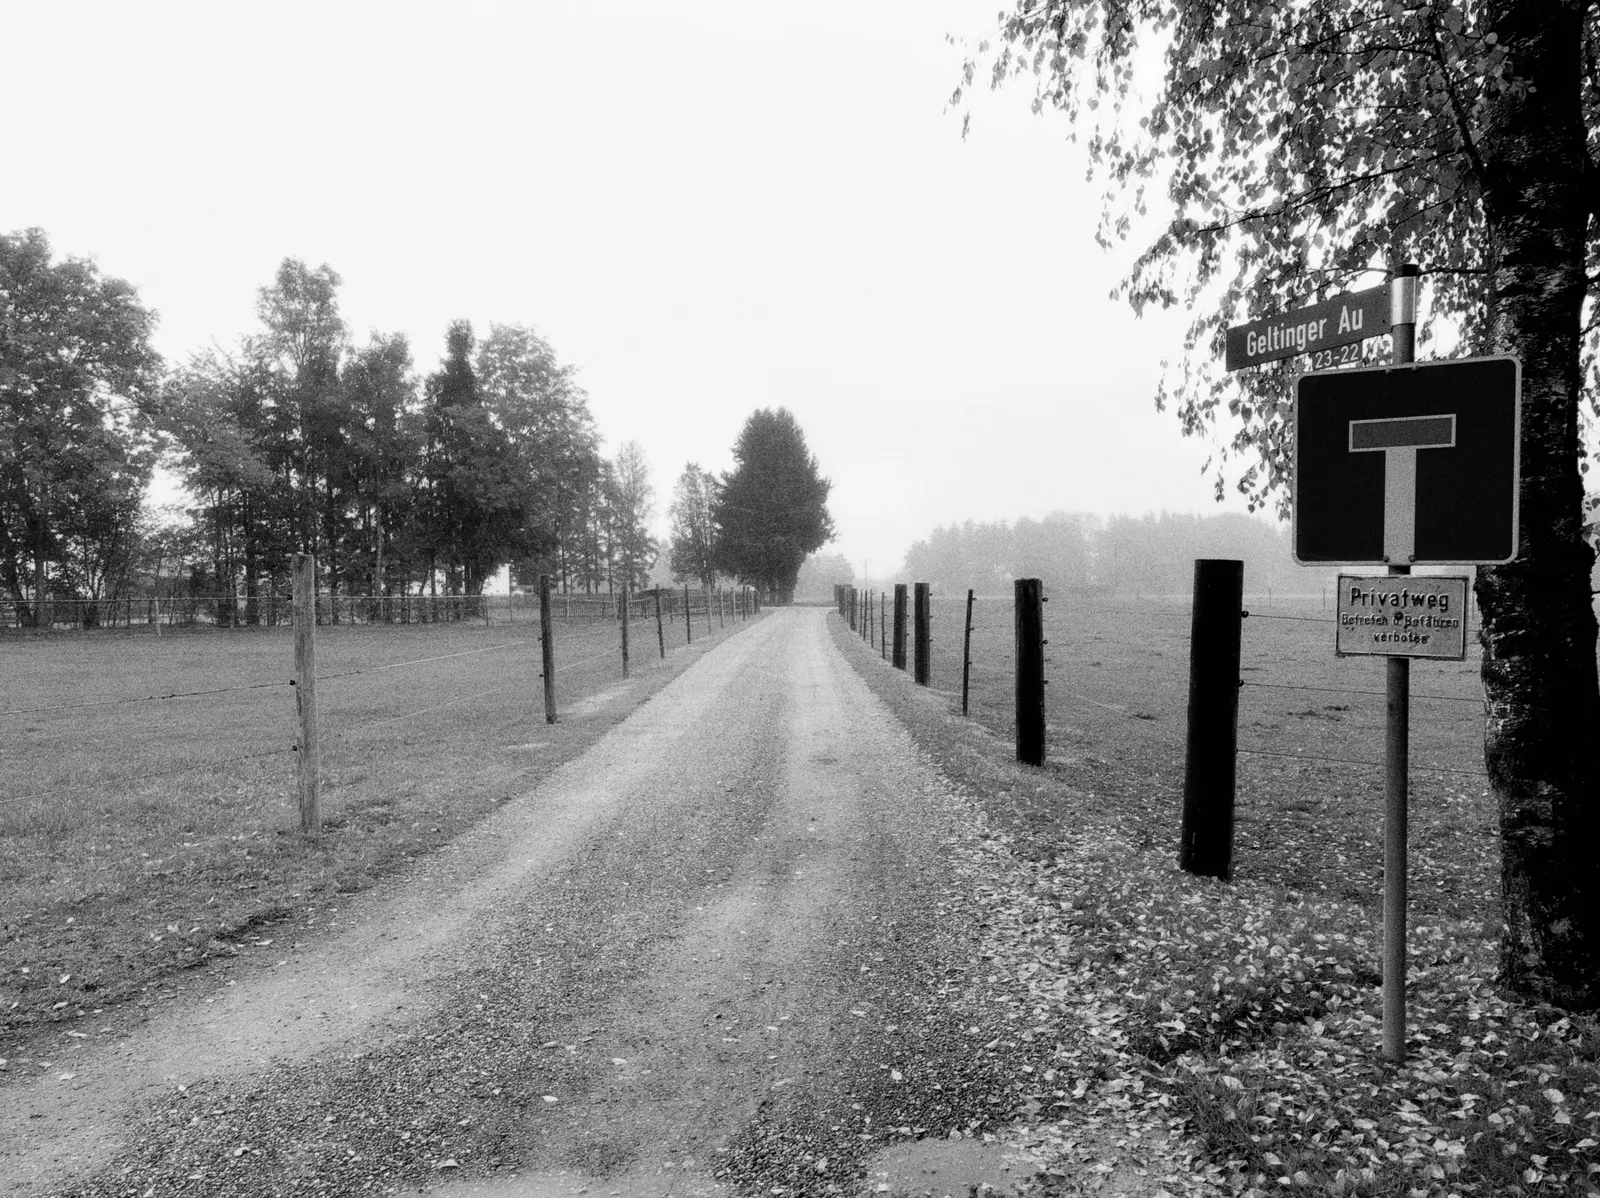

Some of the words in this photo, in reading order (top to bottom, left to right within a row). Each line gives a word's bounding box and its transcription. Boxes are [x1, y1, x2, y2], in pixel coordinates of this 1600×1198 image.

[1246, 318, 1327, 357] Geltinger
[1338, 305, 1363, 335] Au
[1315, 344, 1359, 369] 23-22
[1350, 587, 1449, 613] Privatweg
[1341, 612, 1388, 626] Betreten
